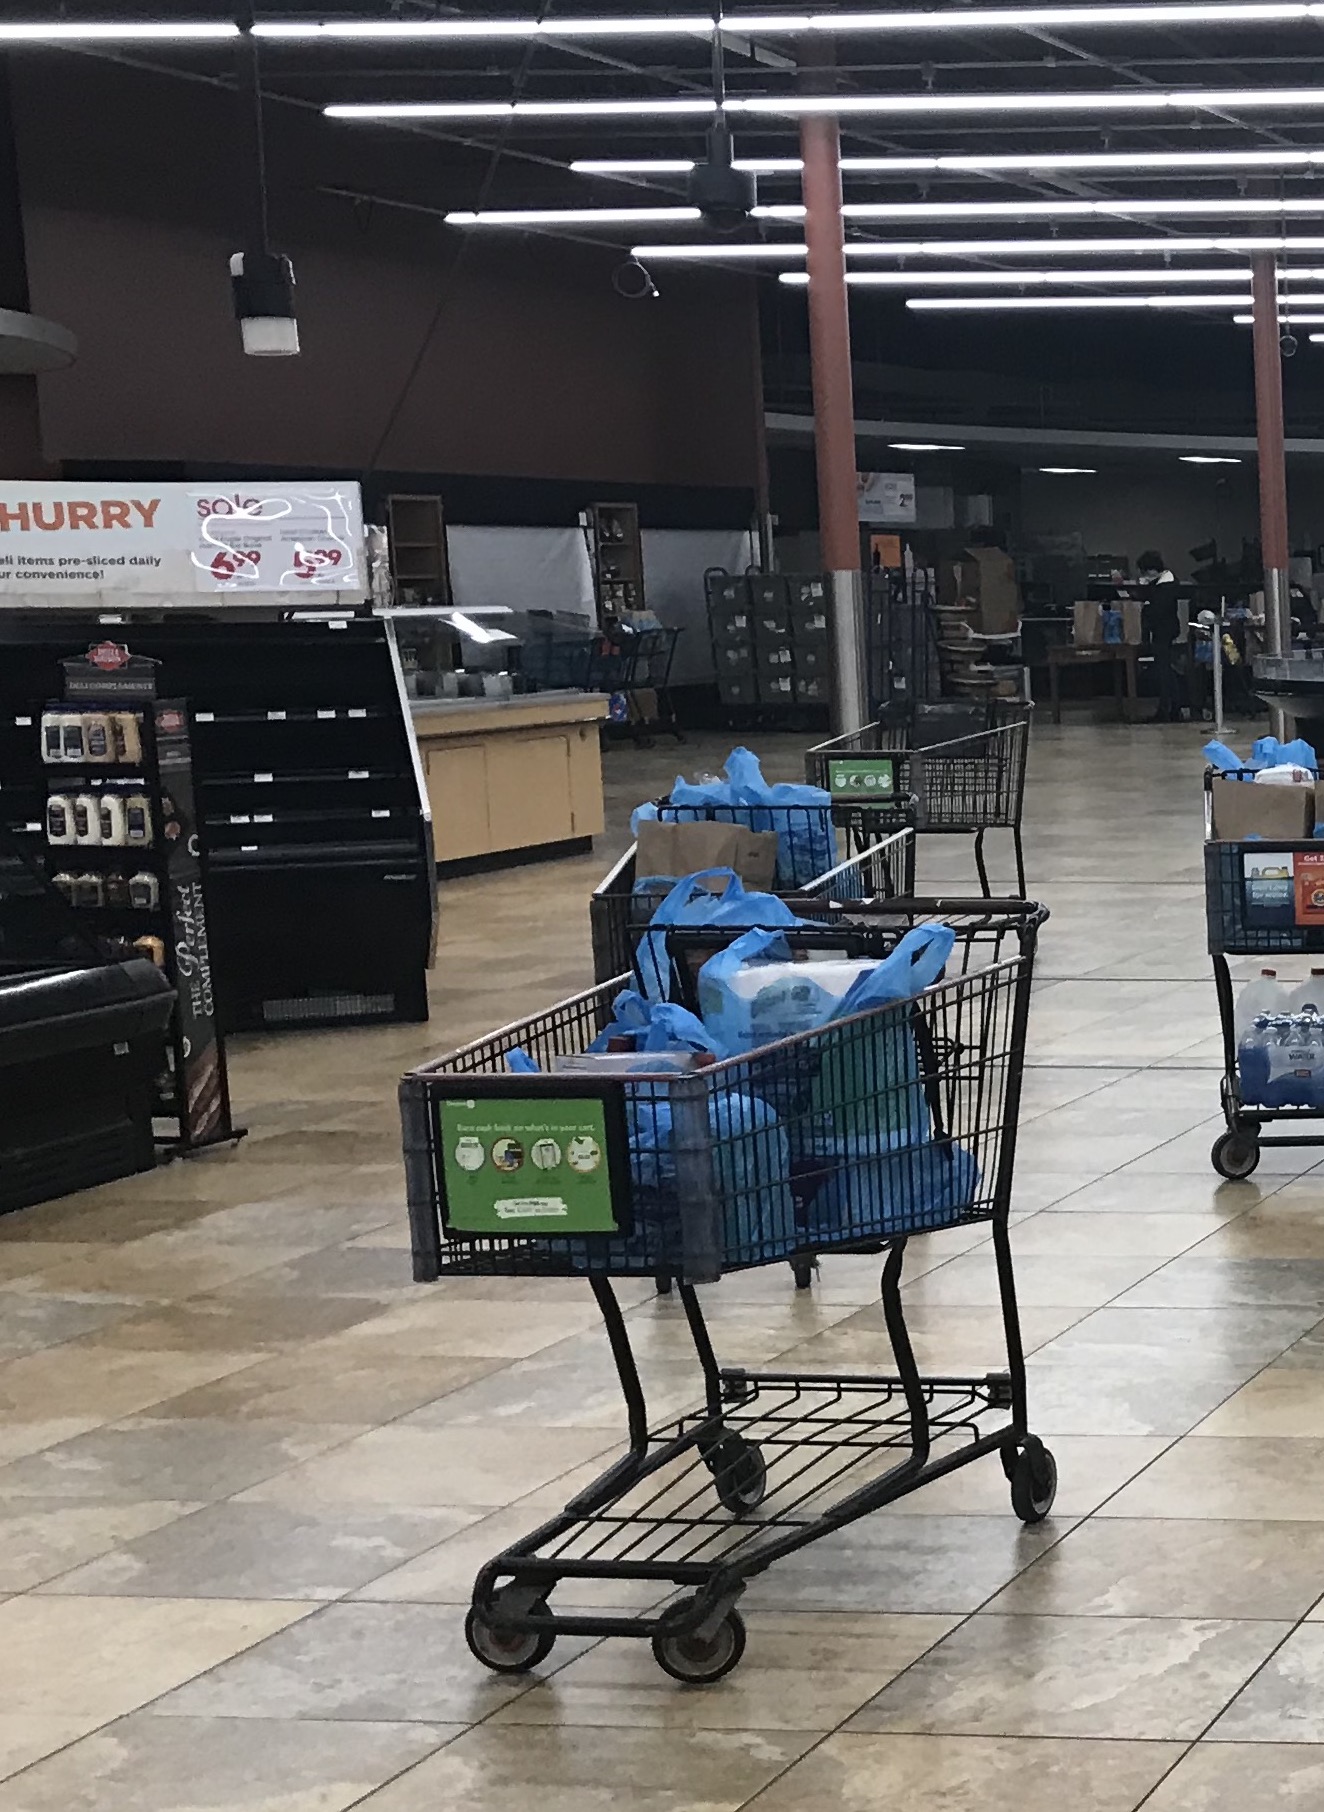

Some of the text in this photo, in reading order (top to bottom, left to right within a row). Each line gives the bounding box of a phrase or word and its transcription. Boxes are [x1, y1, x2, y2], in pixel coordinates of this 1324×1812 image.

[0, 498, 161, 532] HURRY
[197, 493, 264, 519] sale
[15, 568, 105, 581] convenience!
[17, 555, 55, 567] items
[58, 555, 125, 569] pre-sliced
[129, 554, 162, 568] daily
[174, 885, 204, 1020] THE Perfect
[191, 881, 215, 1017] COMPLEMENT
